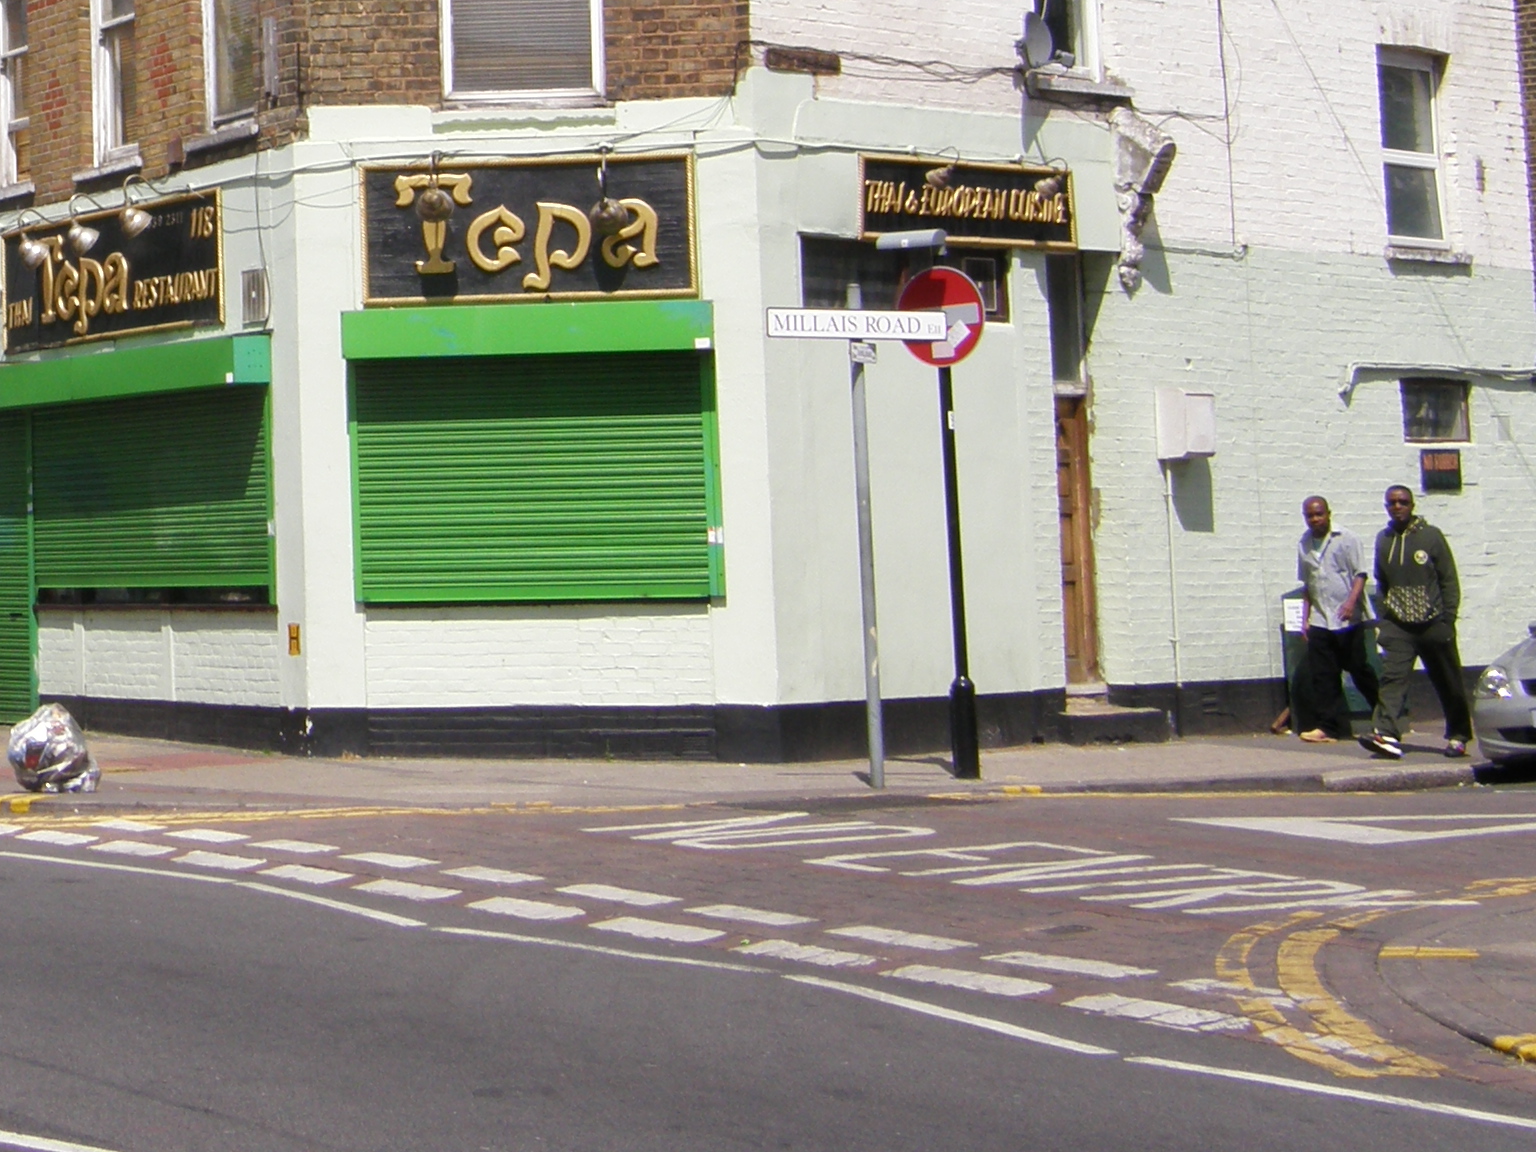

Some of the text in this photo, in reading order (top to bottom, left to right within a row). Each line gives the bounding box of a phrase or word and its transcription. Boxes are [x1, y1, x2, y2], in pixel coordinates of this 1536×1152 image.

[190, 206, 214, 239] 118
[919, 183, 1007, 220] EUROPEAN
[1009, 189, 1068, 224] CUISINE
[395, 173, 659, 290] Tepa
[36, 234, 129, 335] Tepa
[133, 268, 218, 310] RESTAURANT
[774, 314, 857, 333] MILLAIS
[865, 315, 921, 334] ROAD
